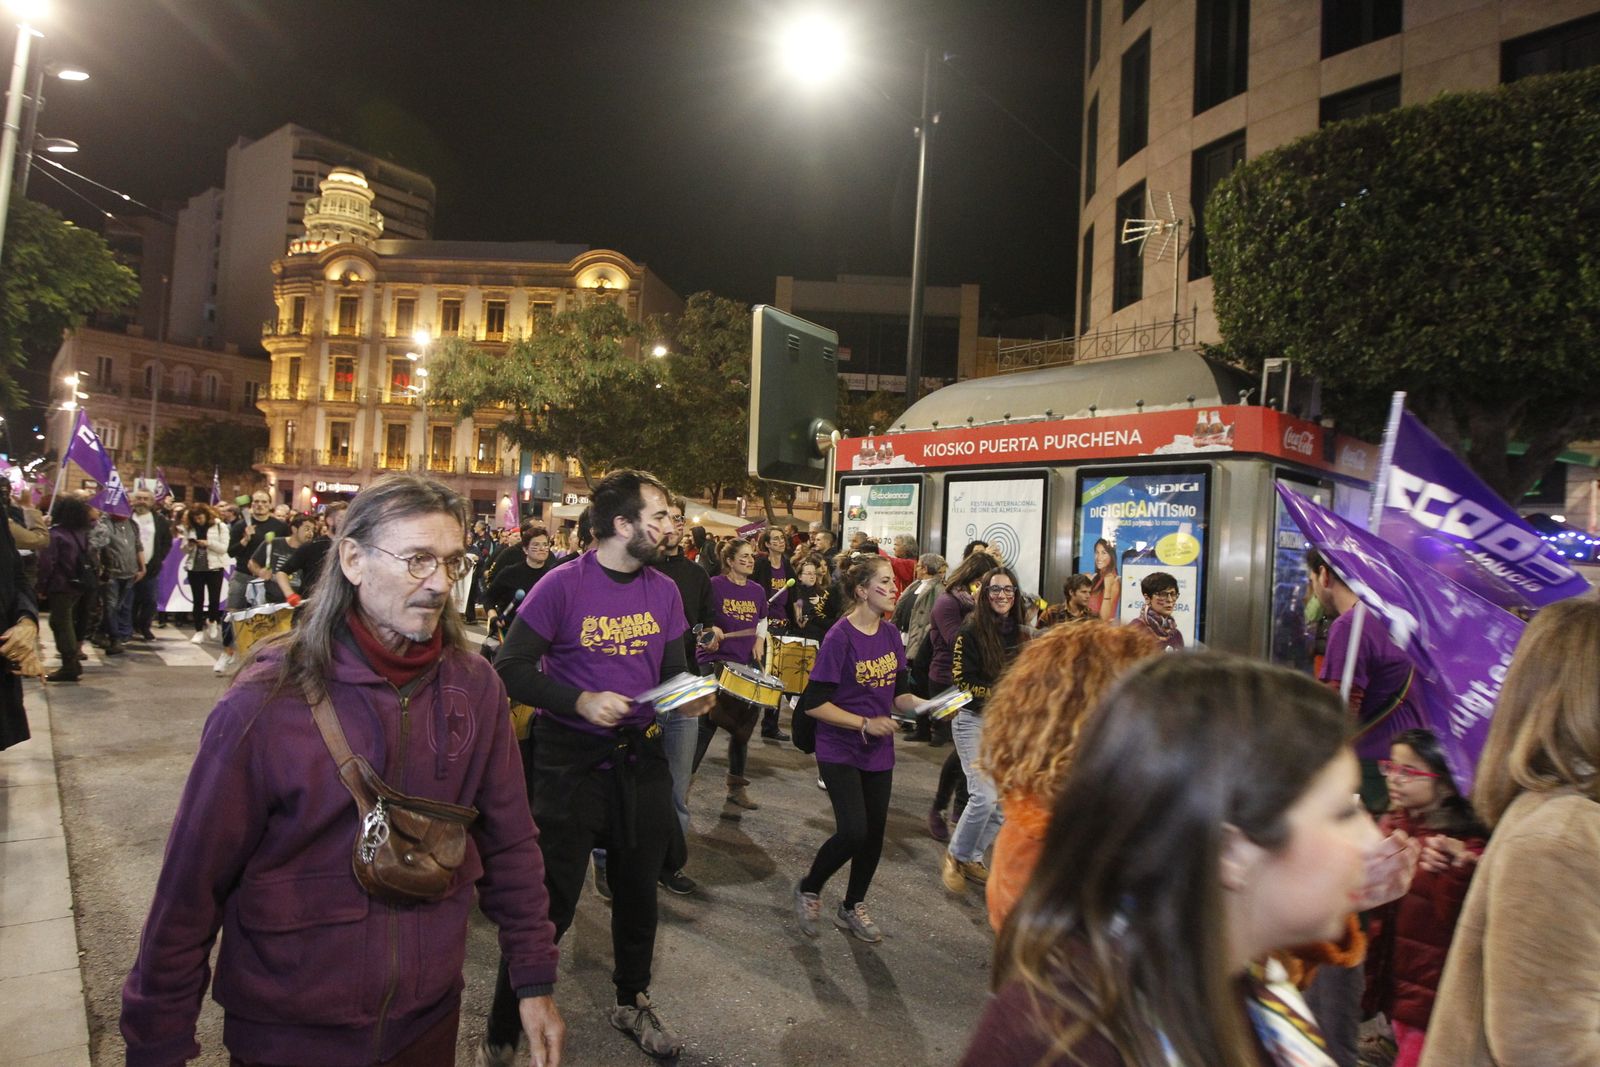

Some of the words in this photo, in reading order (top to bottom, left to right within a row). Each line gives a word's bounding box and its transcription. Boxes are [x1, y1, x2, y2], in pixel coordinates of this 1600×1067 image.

[923, 441, 975, 457] KIOSKO
[980, 437, 1039, 454] PUERTA
[1044, 429, 1143, 450] PURCHENA
